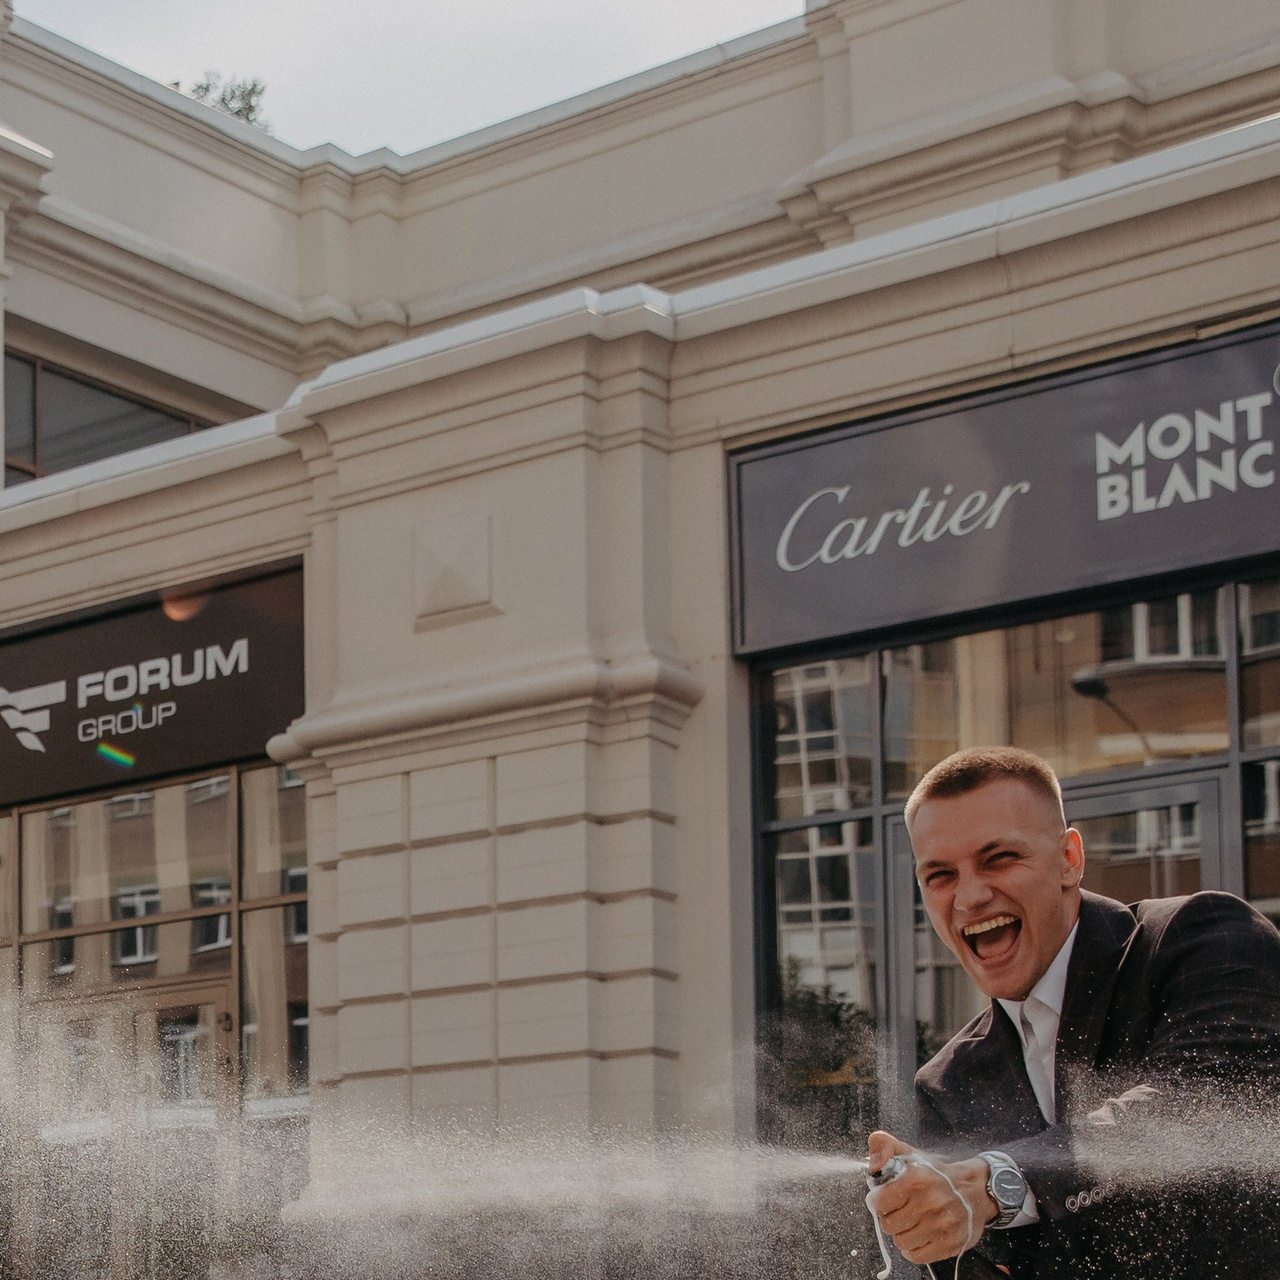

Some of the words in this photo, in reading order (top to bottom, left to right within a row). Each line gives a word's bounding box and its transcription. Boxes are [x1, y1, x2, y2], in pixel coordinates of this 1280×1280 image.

[1095, 391, 1273, 474] MONT
[1096, 440, 1276, 521] BLANC
[775, 481, 1031, 572] Cartier
[76, 637, 250, 709] FORUM
[76, 701, 177, 742] GROUP
